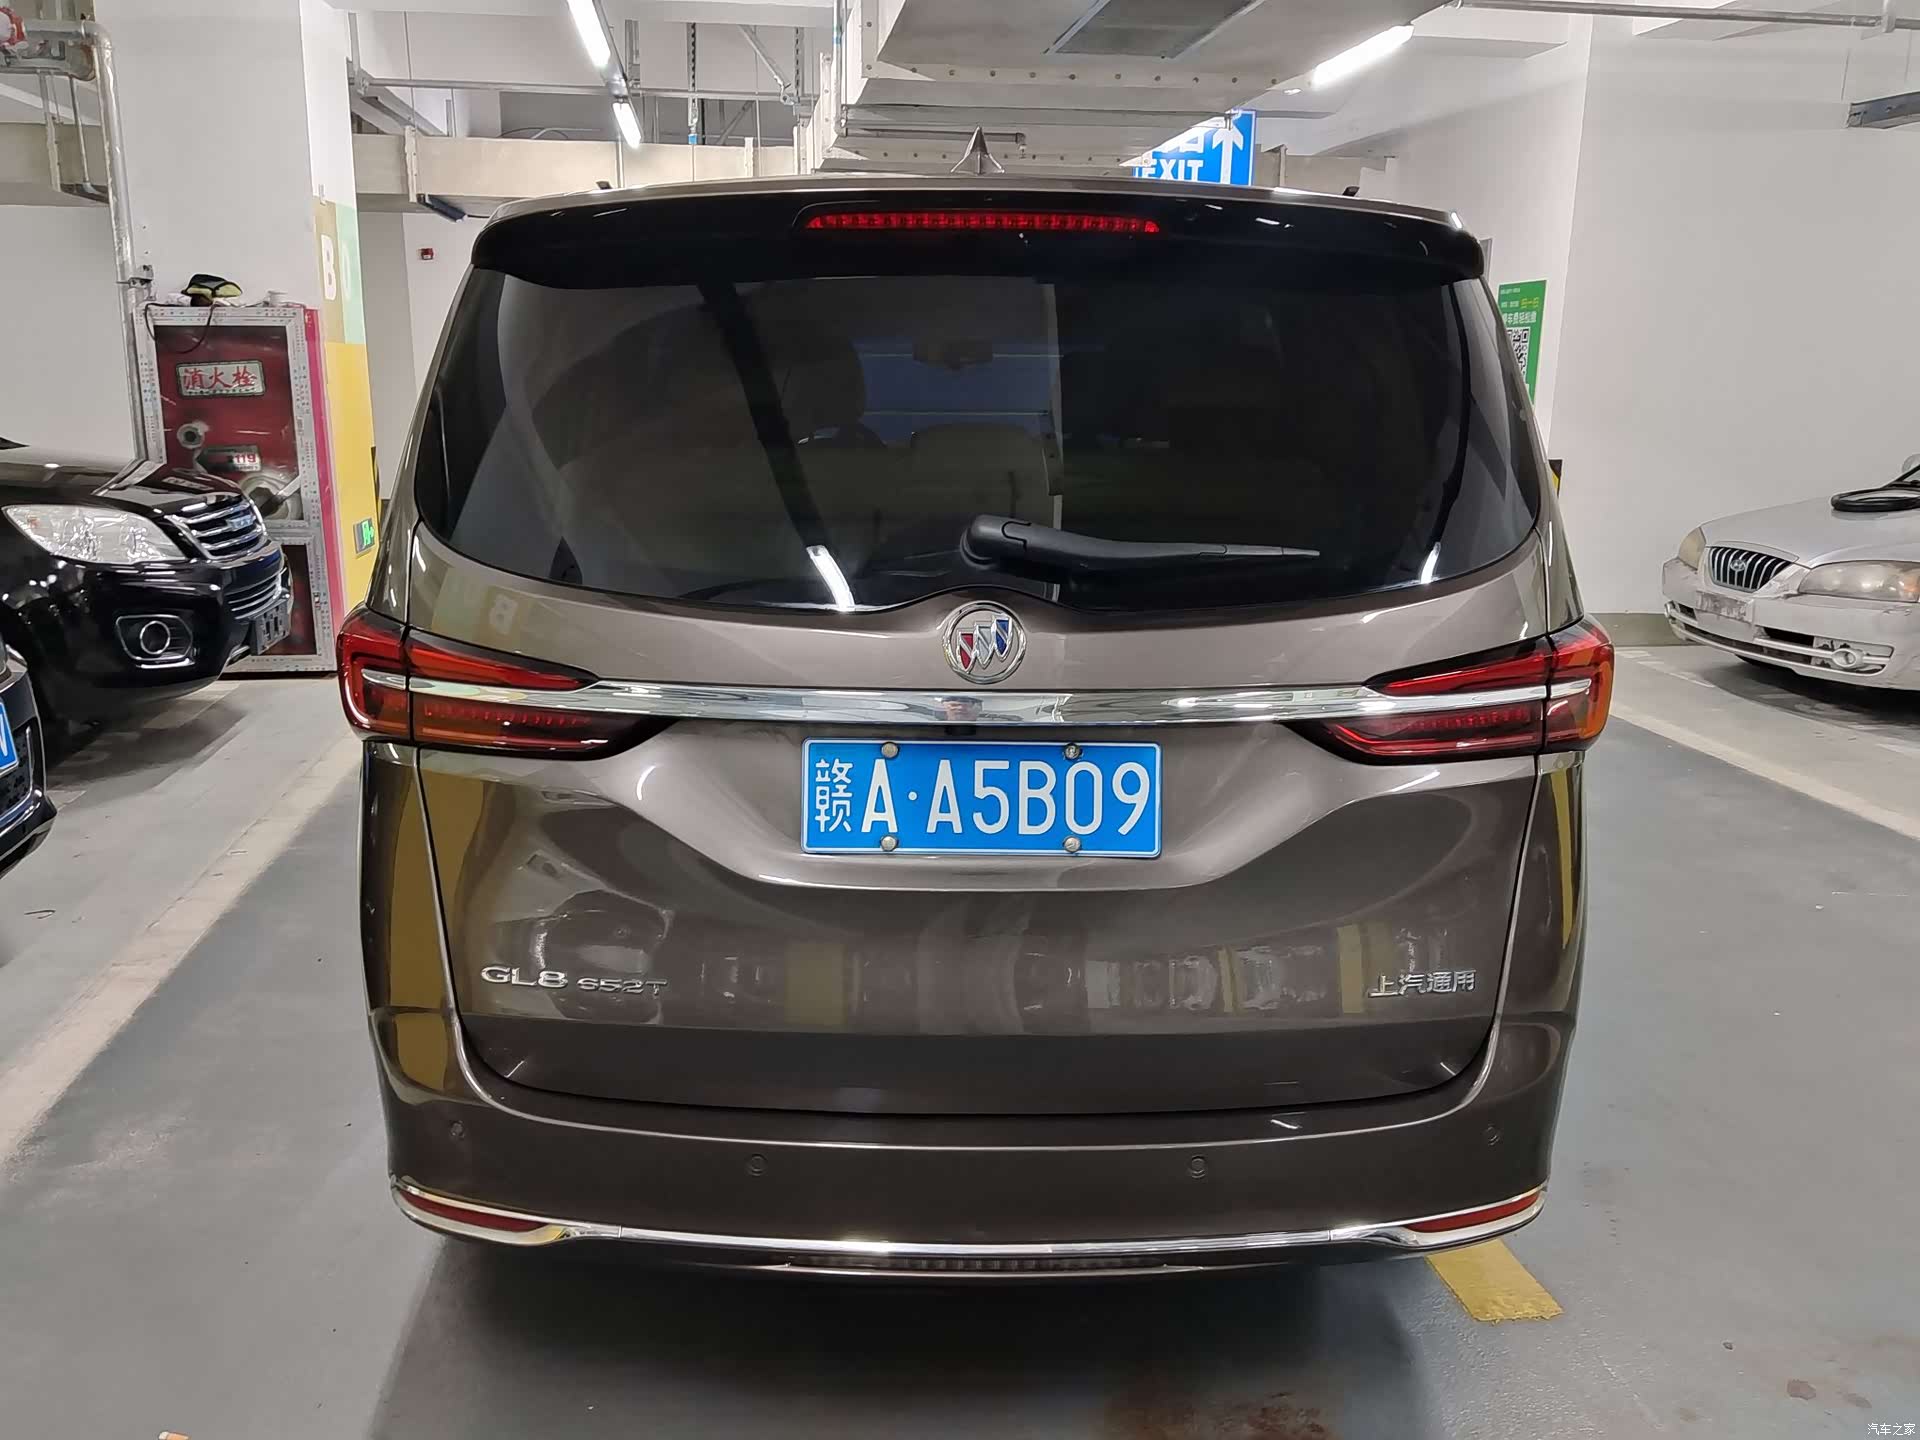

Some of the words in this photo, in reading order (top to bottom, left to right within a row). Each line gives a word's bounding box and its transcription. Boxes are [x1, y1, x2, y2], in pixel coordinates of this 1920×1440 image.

[1141, 158, 1204, 181] EXIT
[320, 234, 337, 301] B
[183, 365, 258, 390] 消火栓
[234, 453, 257, 464] 119
[480, 966, 569, 988] GL8
[576, 977, 668, 994] 652T
[1369, 969, 1476, 997] 上汽通用
